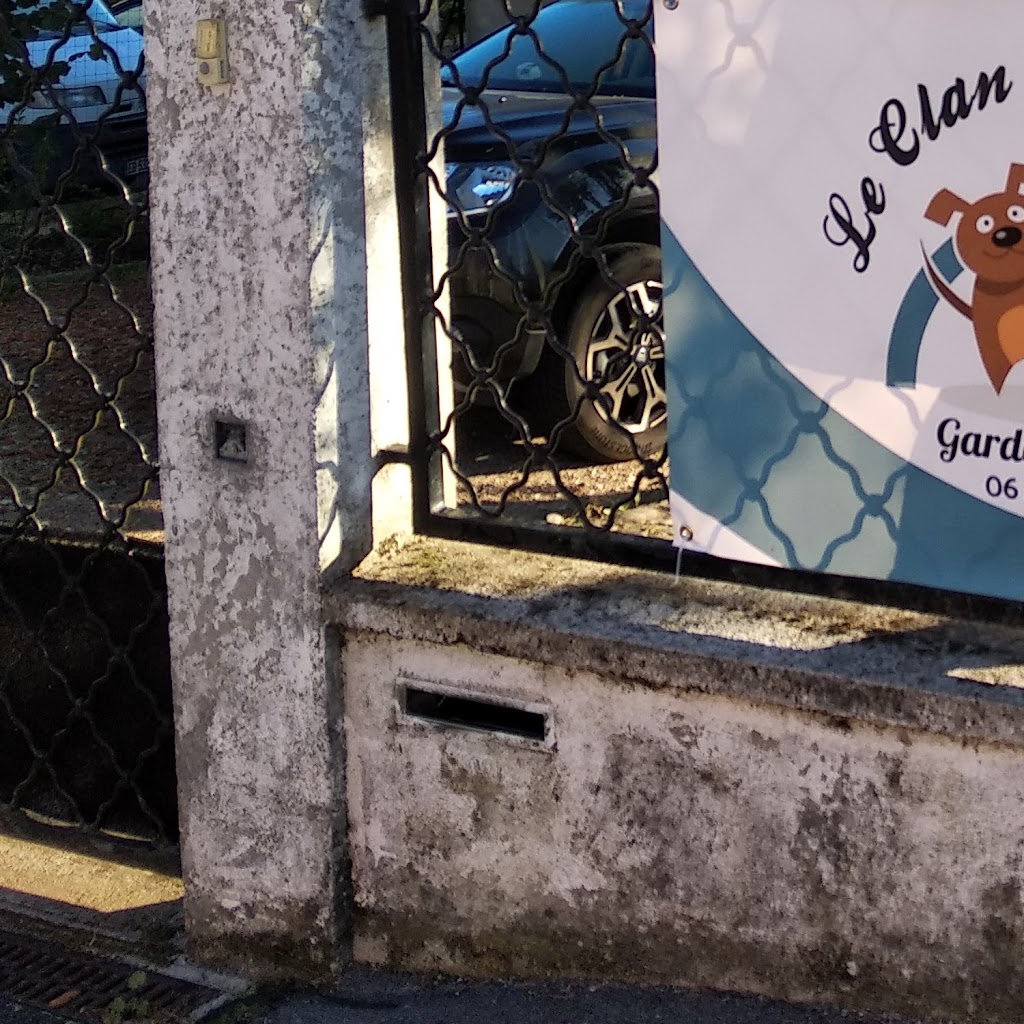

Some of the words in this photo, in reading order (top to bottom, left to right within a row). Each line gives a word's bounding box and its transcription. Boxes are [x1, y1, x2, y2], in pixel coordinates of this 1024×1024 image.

[823, 176, 885, 273] Le
[868, 65, 1012, 166] Clan
[985, 476, 1019, 499] 06
